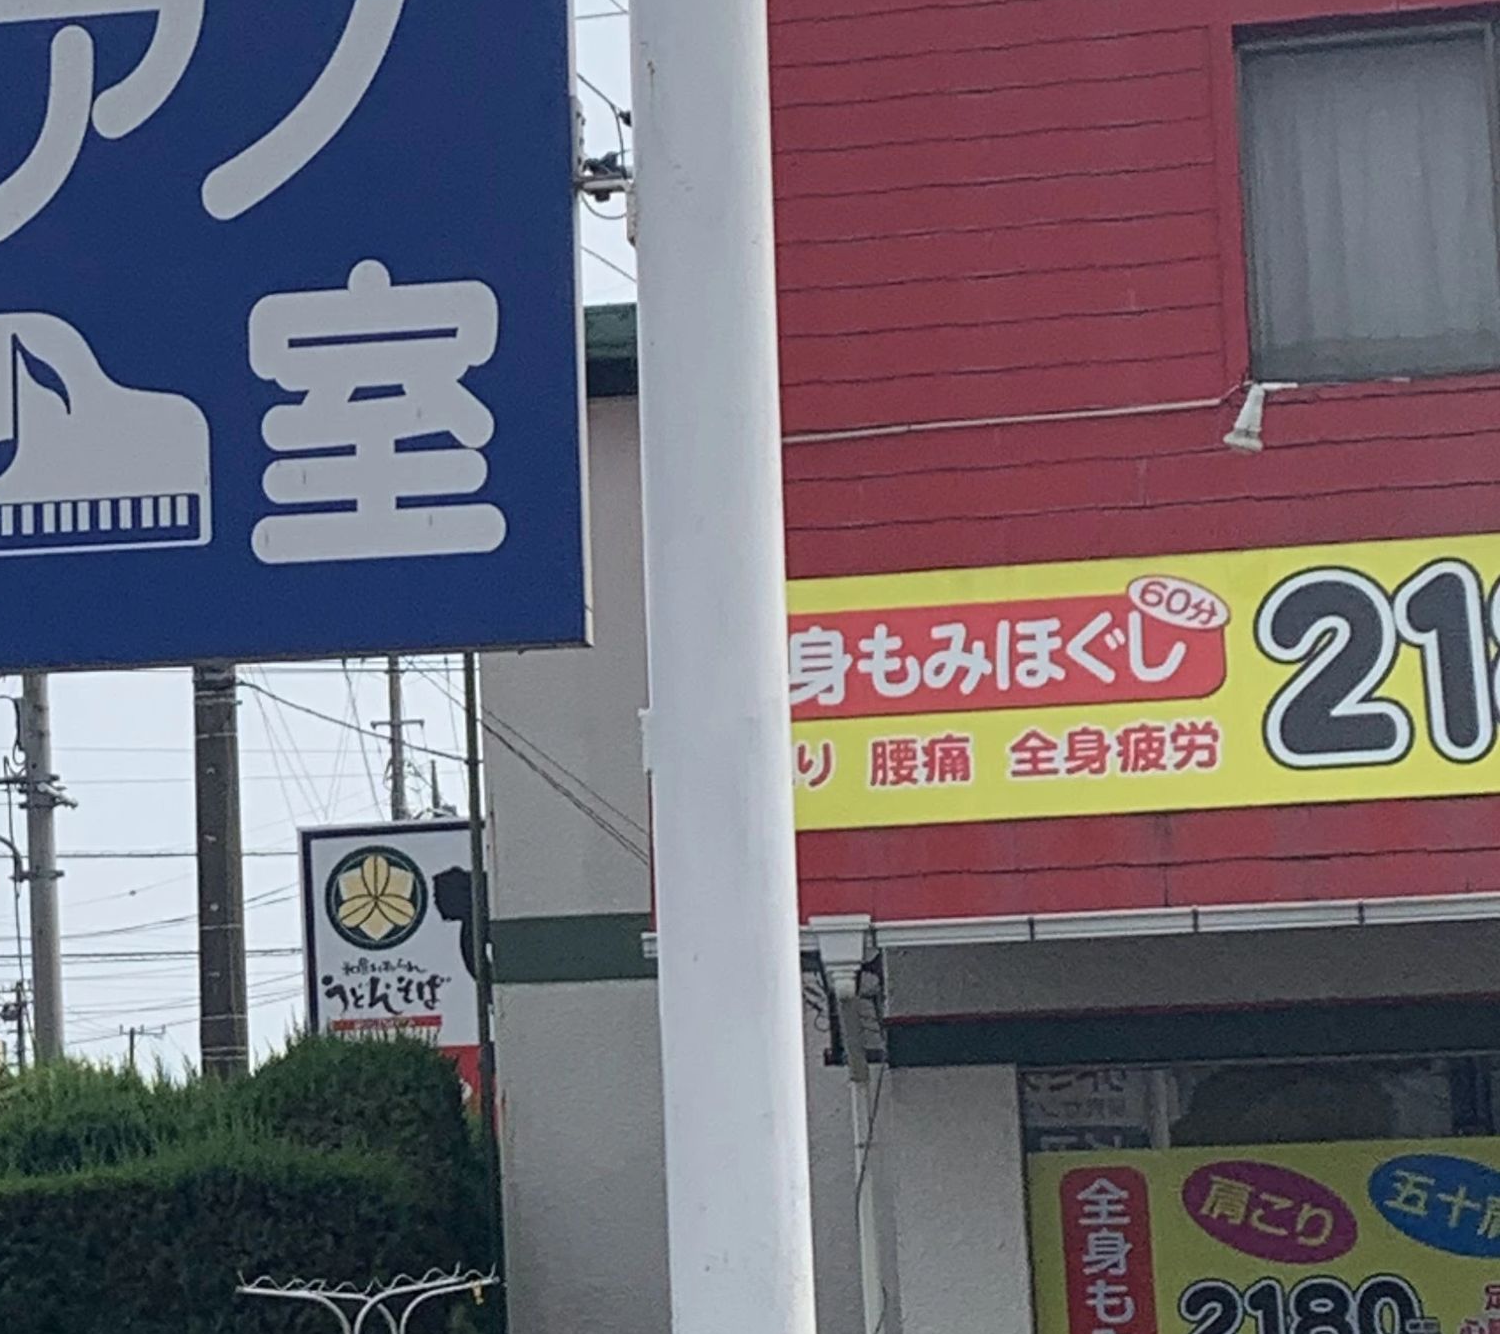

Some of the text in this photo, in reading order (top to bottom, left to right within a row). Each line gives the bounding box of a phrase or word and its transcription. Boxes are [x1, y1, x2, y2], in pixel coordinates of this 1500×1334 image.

[1138, 580, 1219, 626] 60分
[789, 610, 1186, 705] 身もみほぐし
[1253, 557, 1500, 770] 21
[792, 720, 1221, 787] り 腰痛 全身疲労
[322, 974, 452, 1015] うどんそば
[1200, 1175, 1335, 1248] 肩こり
